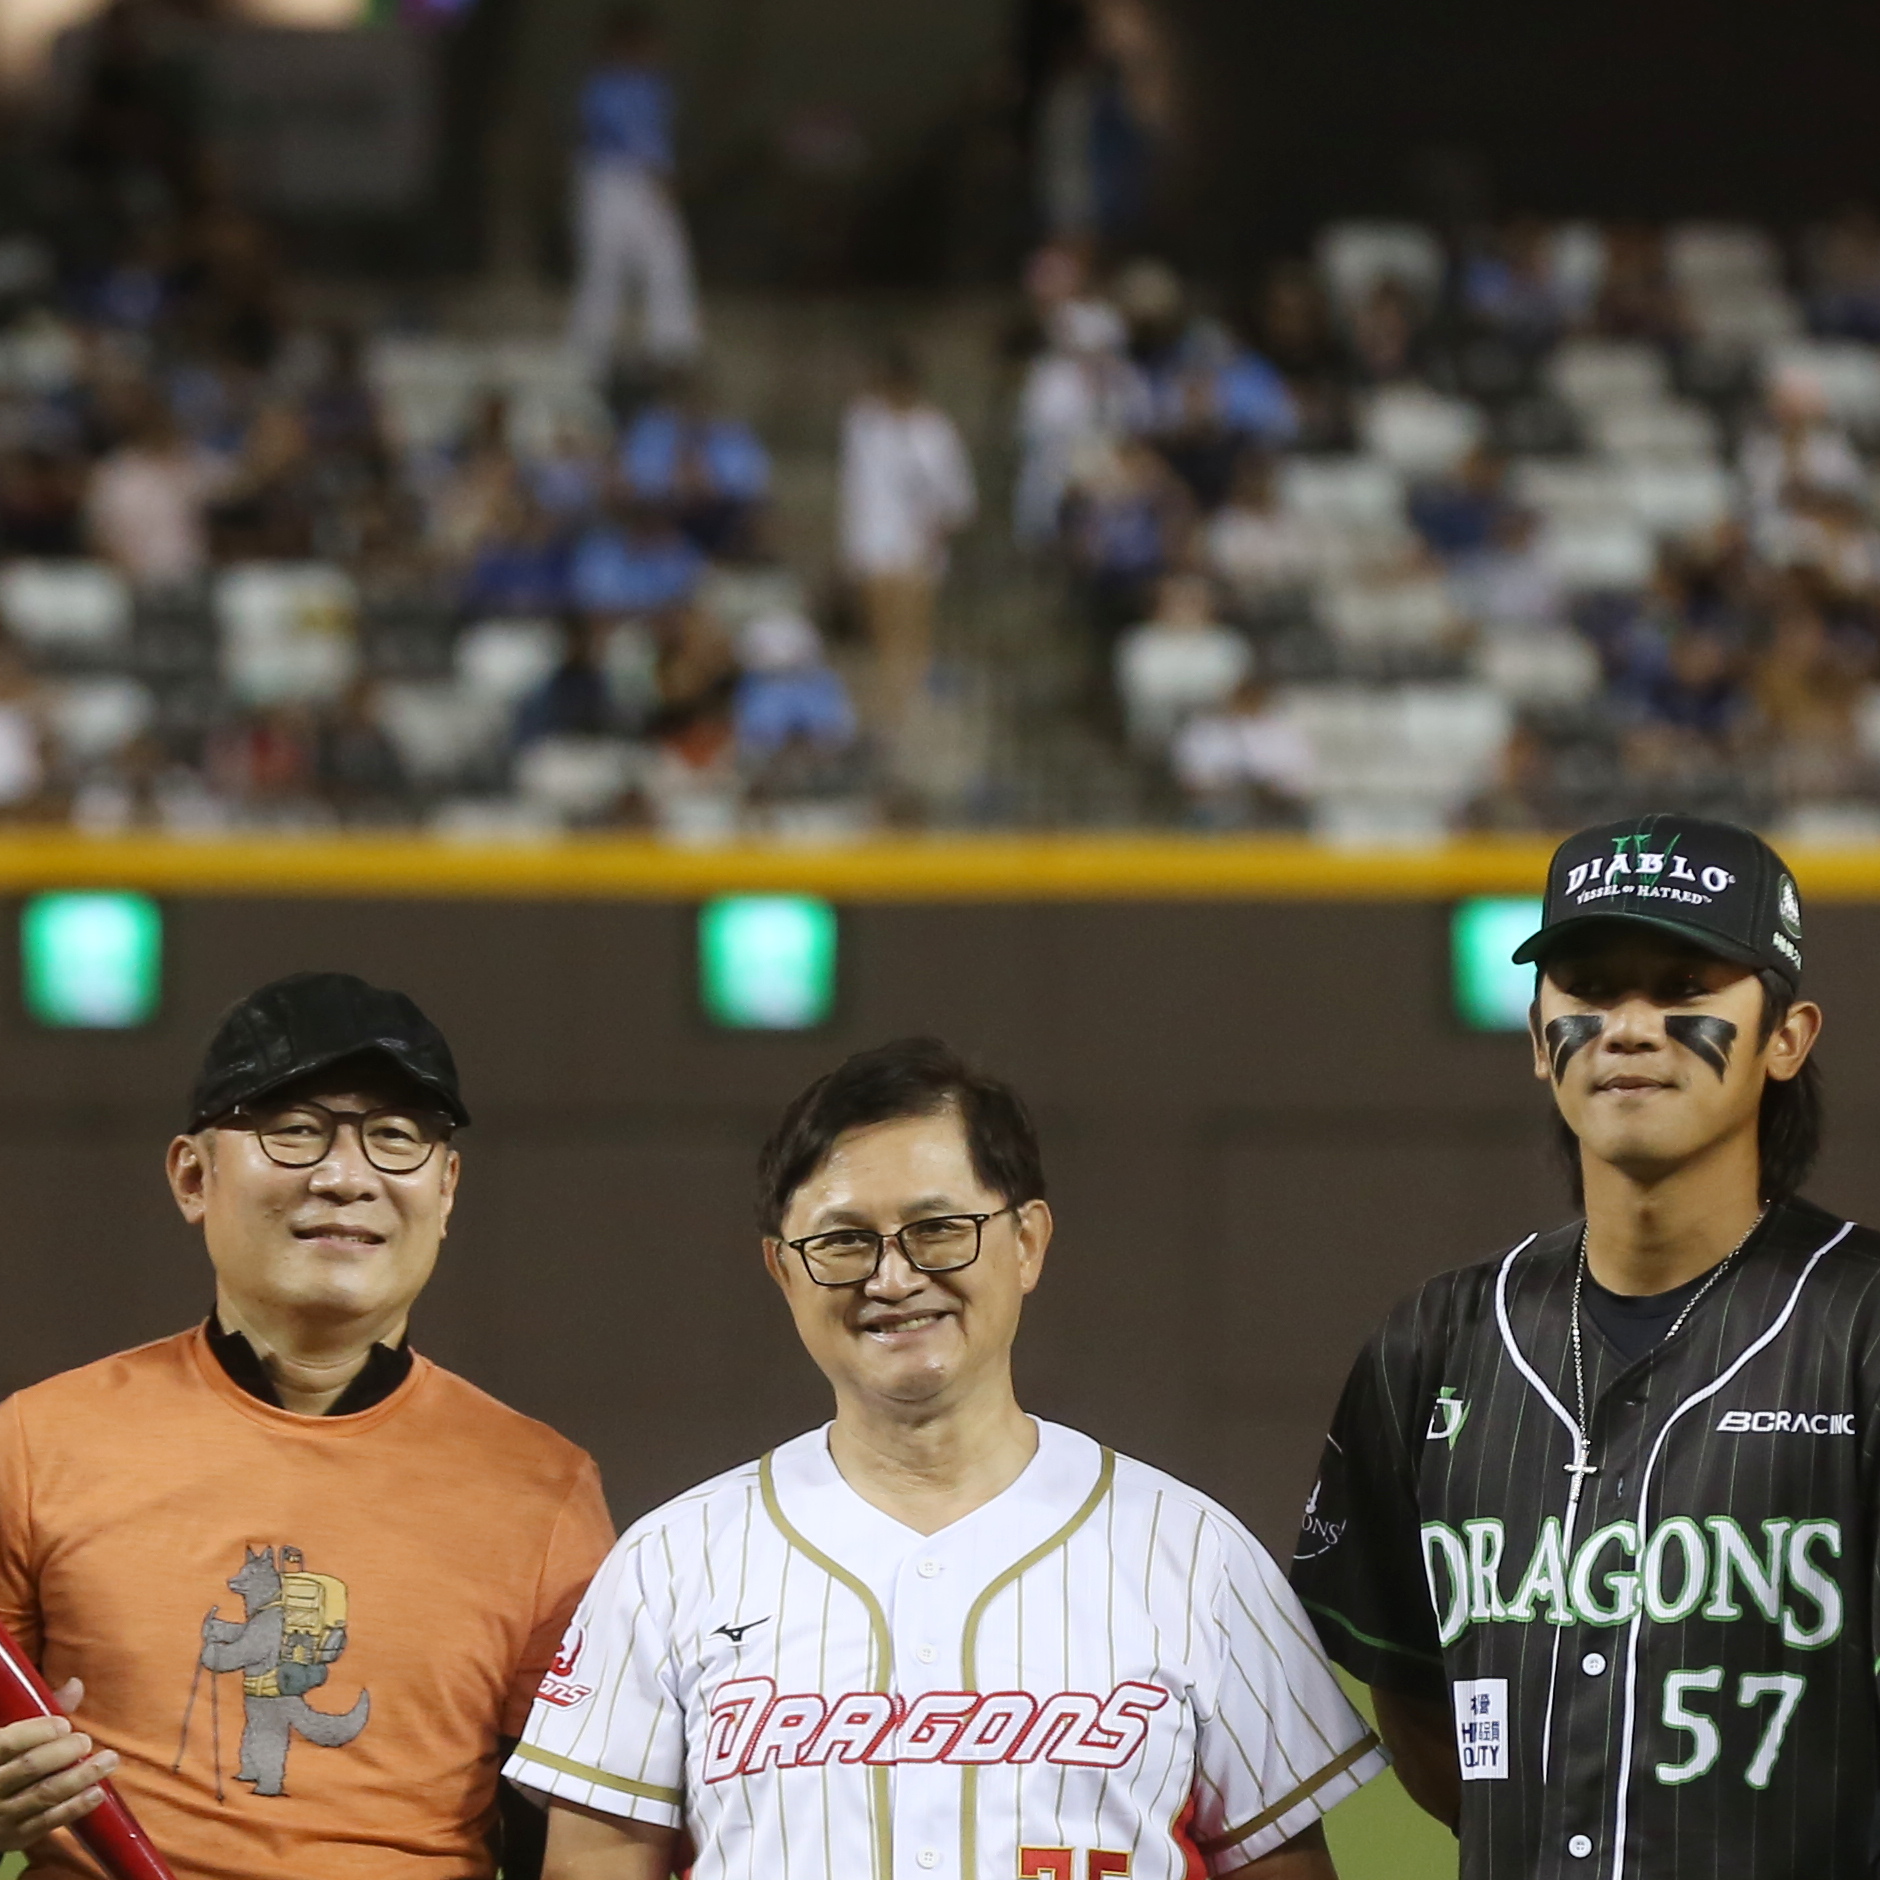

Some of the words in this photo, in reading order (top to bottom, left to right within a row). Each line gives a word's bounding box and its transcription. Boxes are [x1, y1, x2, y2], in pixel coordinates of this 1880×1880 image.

[1565, 853, 1730, 895] DIABLO
[1576, 884, 1620, 905] VESSEL
[1637, 884, 1704, 905] HATRED
[1420, 1515, 1844, 1650] DRAGONS
[704, 1676, 1169, 1785] DRAGONS
[1655, 1665, 1808, 1791] 57
